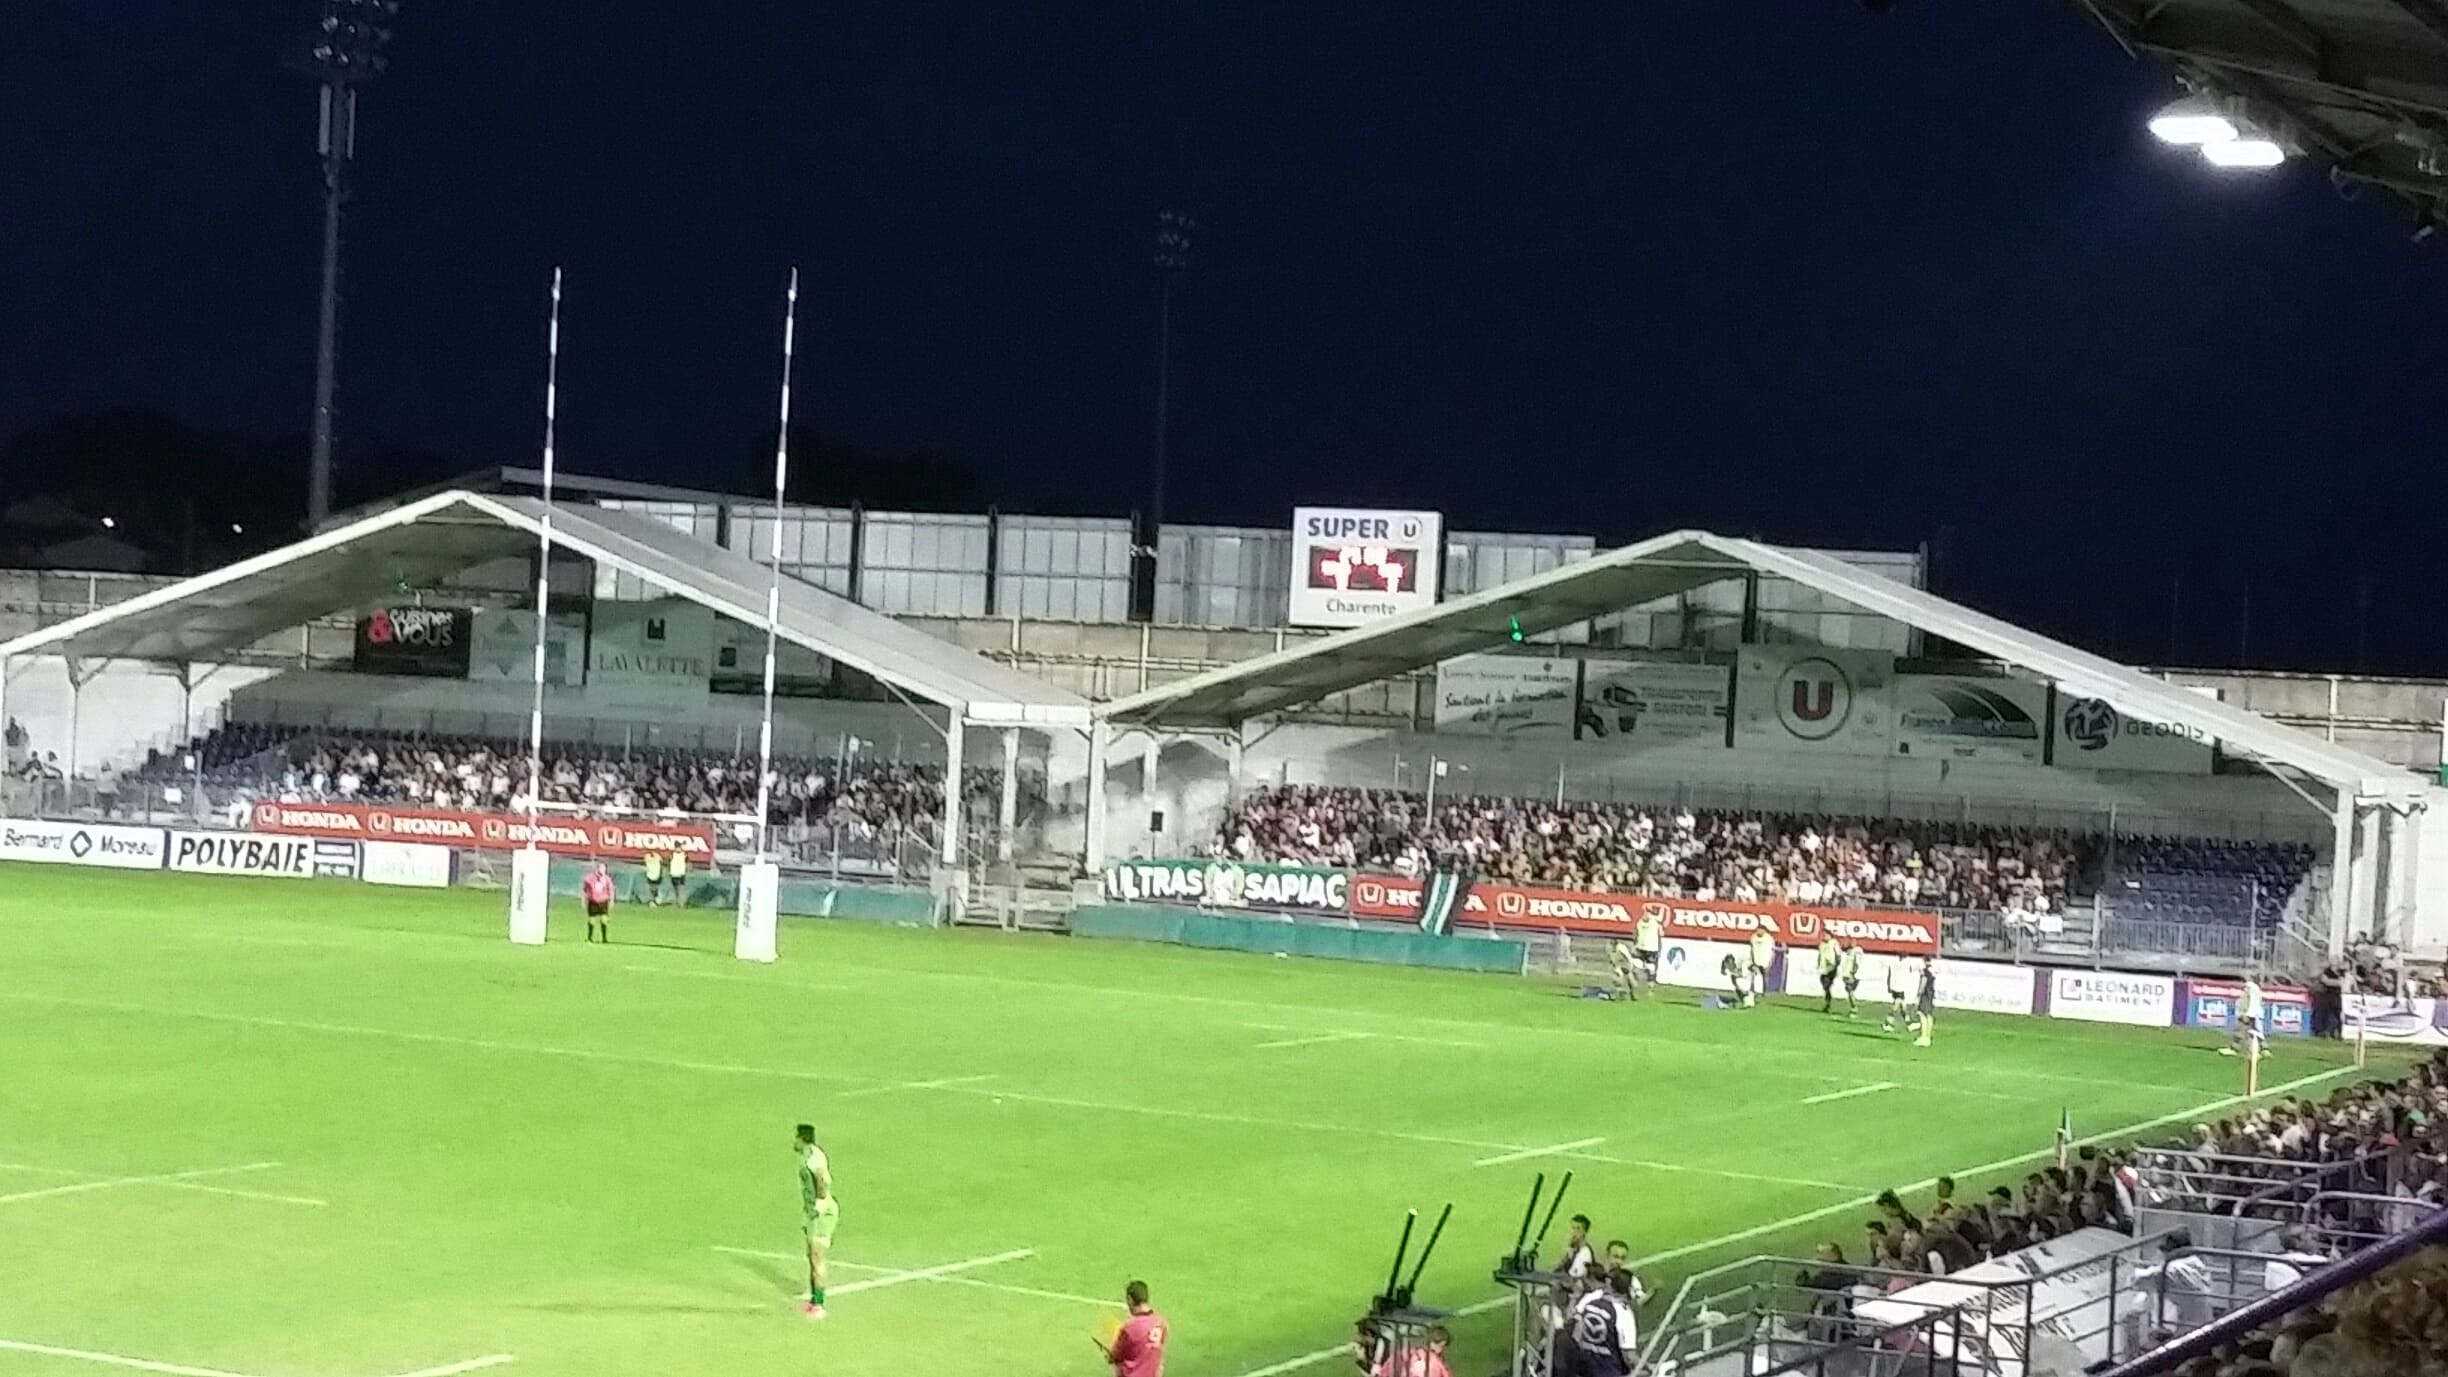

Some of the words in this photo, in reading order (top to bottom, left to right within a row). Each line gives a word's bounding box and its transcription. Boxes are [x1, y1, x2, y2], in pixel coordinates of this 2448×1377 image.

[1308, 517, 1389, 539] SUPER
[1403, 523, 1417, 538] U
[1326, 599, 1397, 615] Charente
[1793, 680, 1834, 721] U
[2126, 719, 2204, 740] GEODIS
[281, 810, 361, 831] HONDA
[393, 816, 476, 838] HONDA
[508, 823, 592, 846] HONDA
[623, 831, 712, 853] HONDA
[177, 836, 309, 874] POLYBAIE
[1244, 873, 1347, 908] SAPIAC
[1527, 898, 1632, 922] HONDA
[1673, 907, 1781, 932] HONDA
[1823, 917, 1934, 943] HONDA
